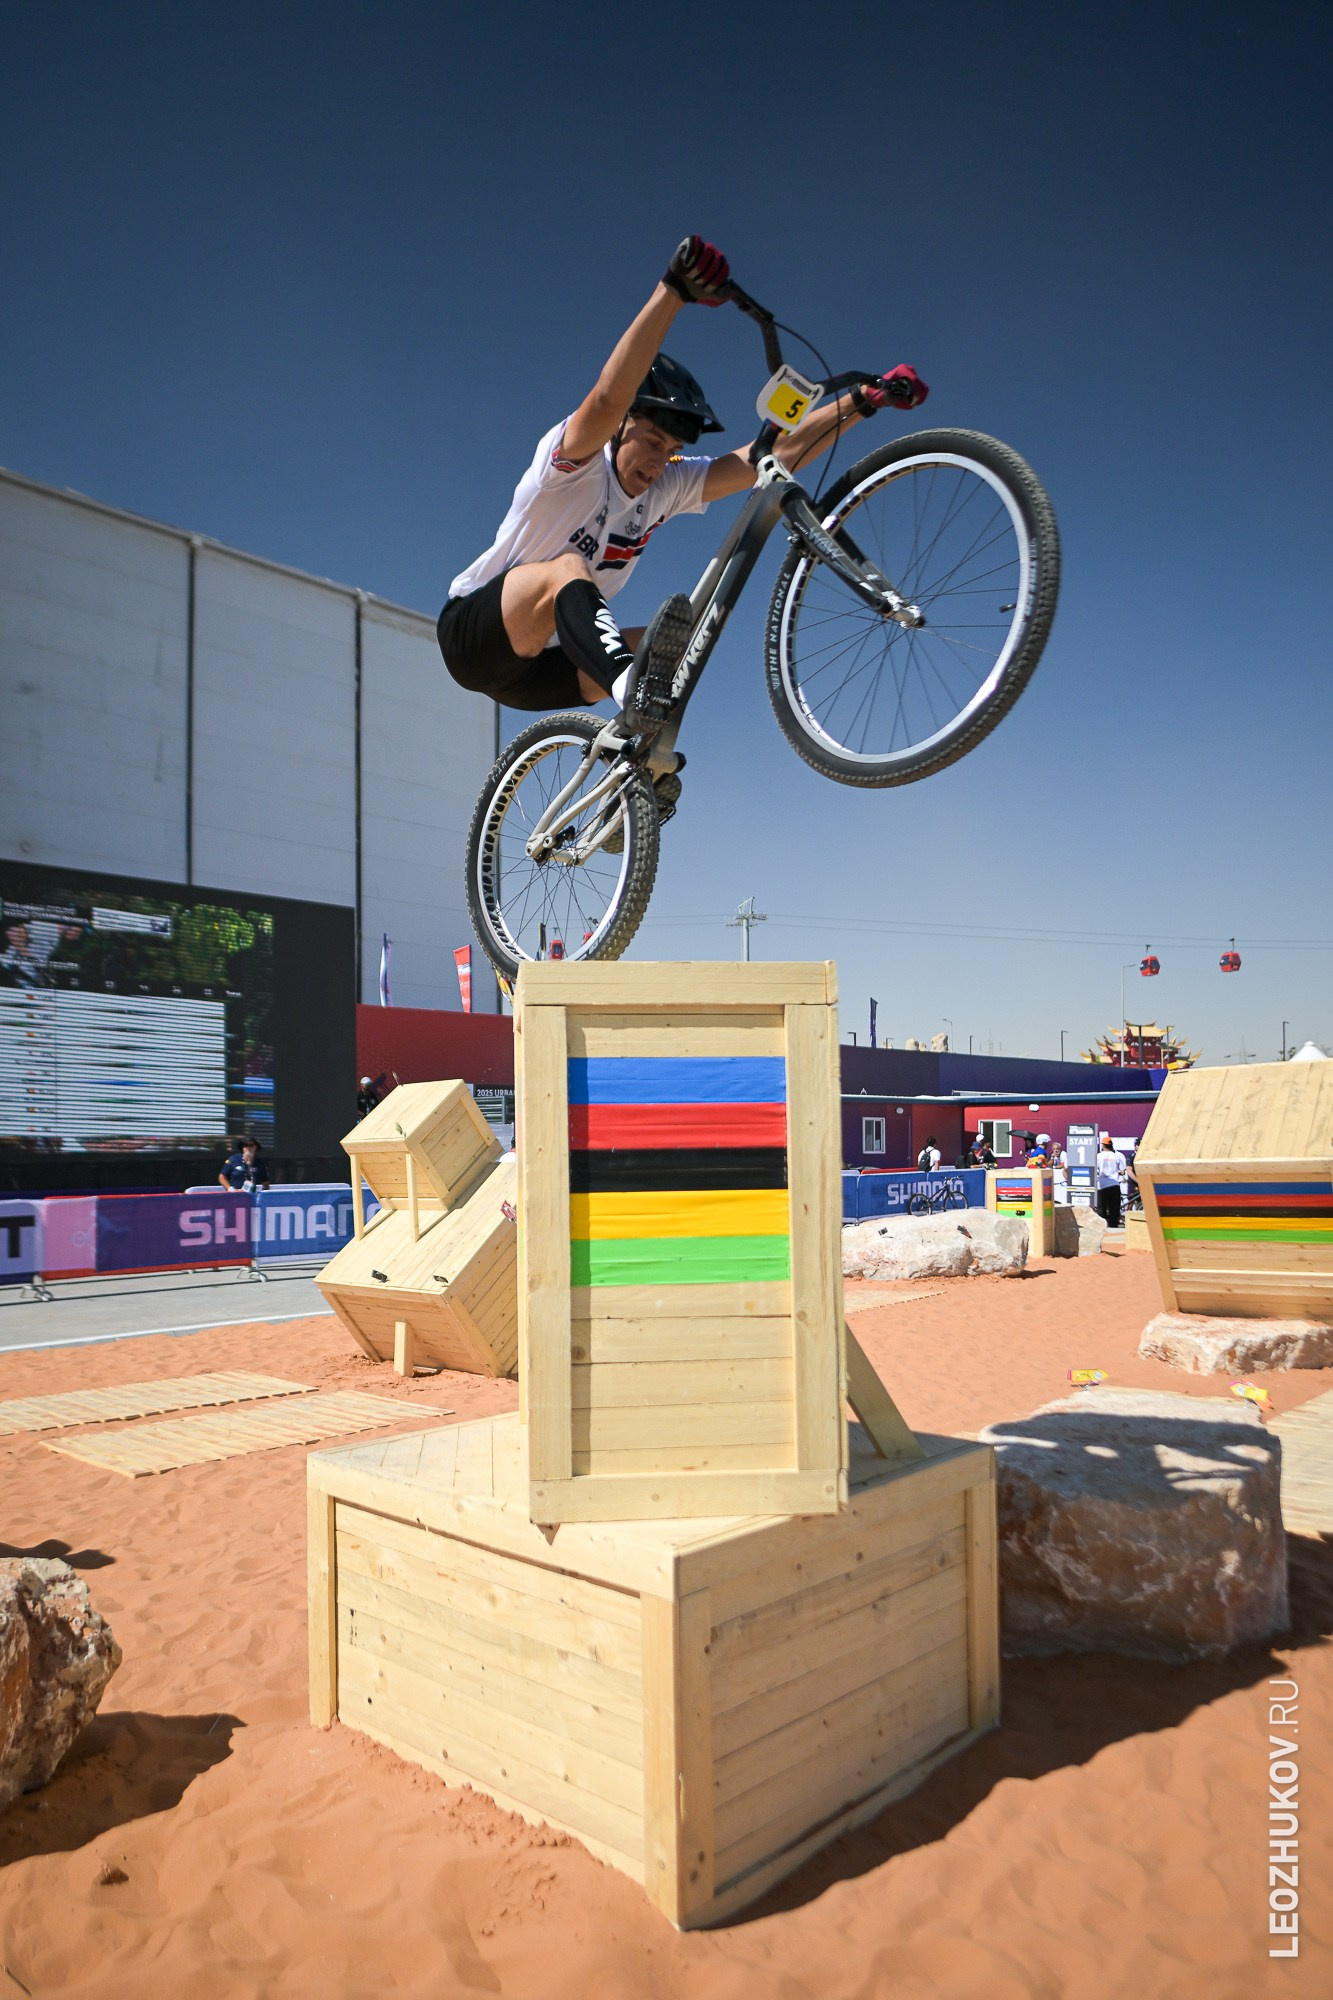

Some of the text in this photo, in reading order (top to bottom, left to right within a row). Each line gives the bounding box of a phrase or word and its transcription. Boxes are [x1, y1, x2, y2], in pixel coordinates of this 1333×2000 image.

[785, 399, 804, 418] 5
[568, 527, 599, 561] GBR
[769, 572, 791, 642] NATIONAL
[769, 649, 779, 674] THE
[477, 1089, 515, 1097] 2025 URBA
[1069, 1138, 1093, 1146] START
[1077, 1146, 1085, 1164] 1
